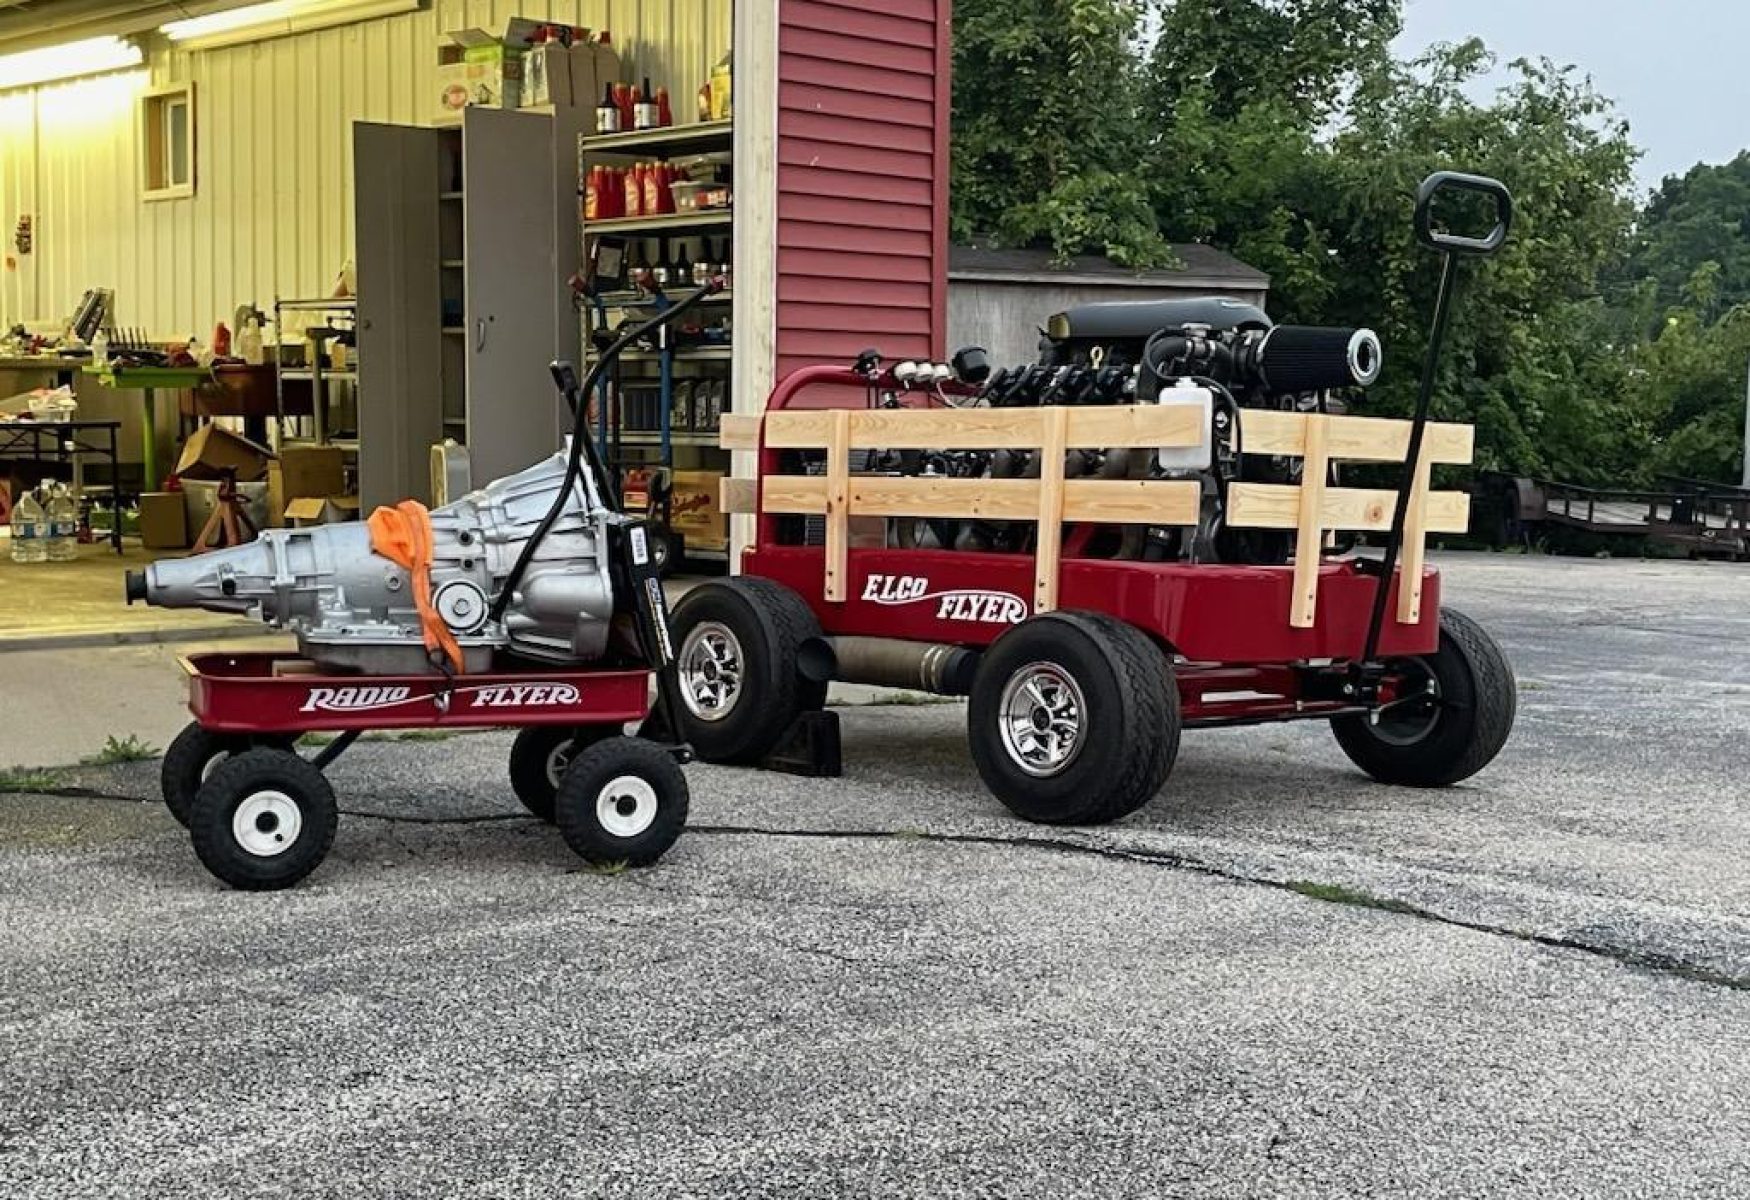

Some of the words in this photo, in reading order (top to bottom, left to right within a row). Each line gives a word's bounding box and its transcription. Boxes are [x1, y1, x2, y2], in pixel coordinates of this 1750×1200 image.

[861, 574, 929, 602] ELCO
[936, 594, 1028, 625] FLYER
[300, 686, 411, 712] RADIO
[471, 683, 582, 707] FLYER
